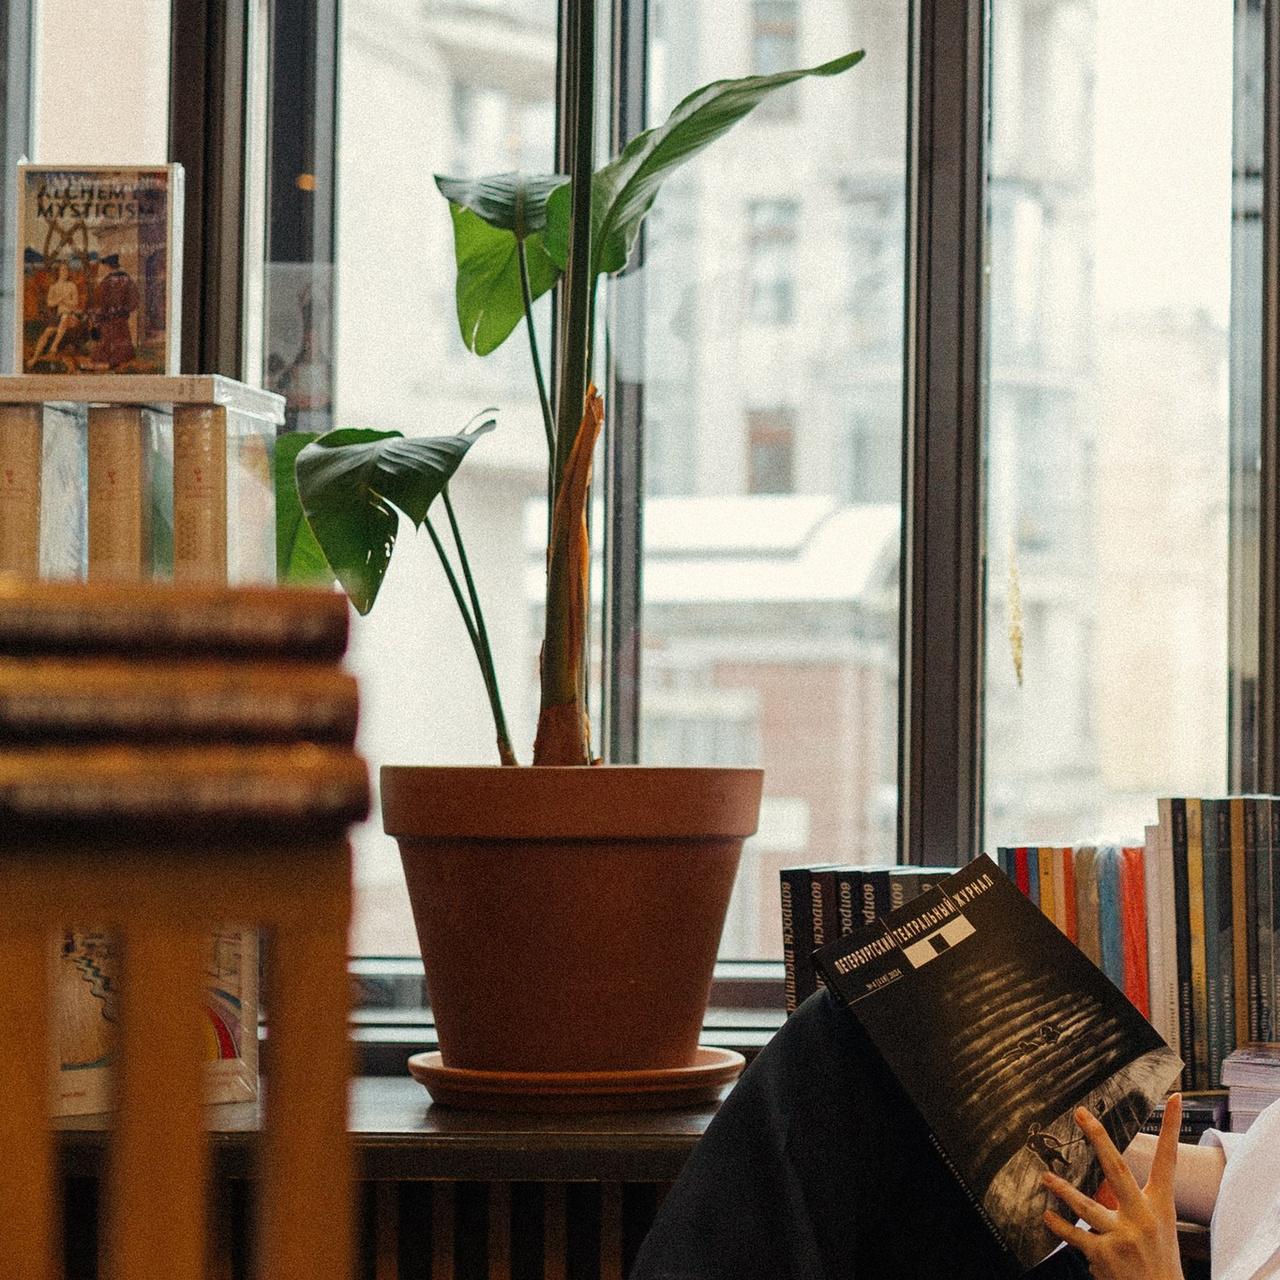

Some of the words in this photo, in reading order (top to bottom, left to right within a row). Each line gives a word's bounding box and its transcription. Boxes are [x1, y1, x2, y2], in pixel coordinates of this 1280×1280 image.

[37, 203, 155, 218] MYSTICISM
[781, 881, 794, 945] вопросы
[811, 882, 824, 945] вопросы
[834, 931, 897, 975] ПЕТЕРБУРГСКИЙ
[892, 897, 957, 944] ТЕАТРАЛЬНЫЙ
[952, 873, 994, 908] ЖУРНАЛ
[840, 882, 854, 937] вопрос
